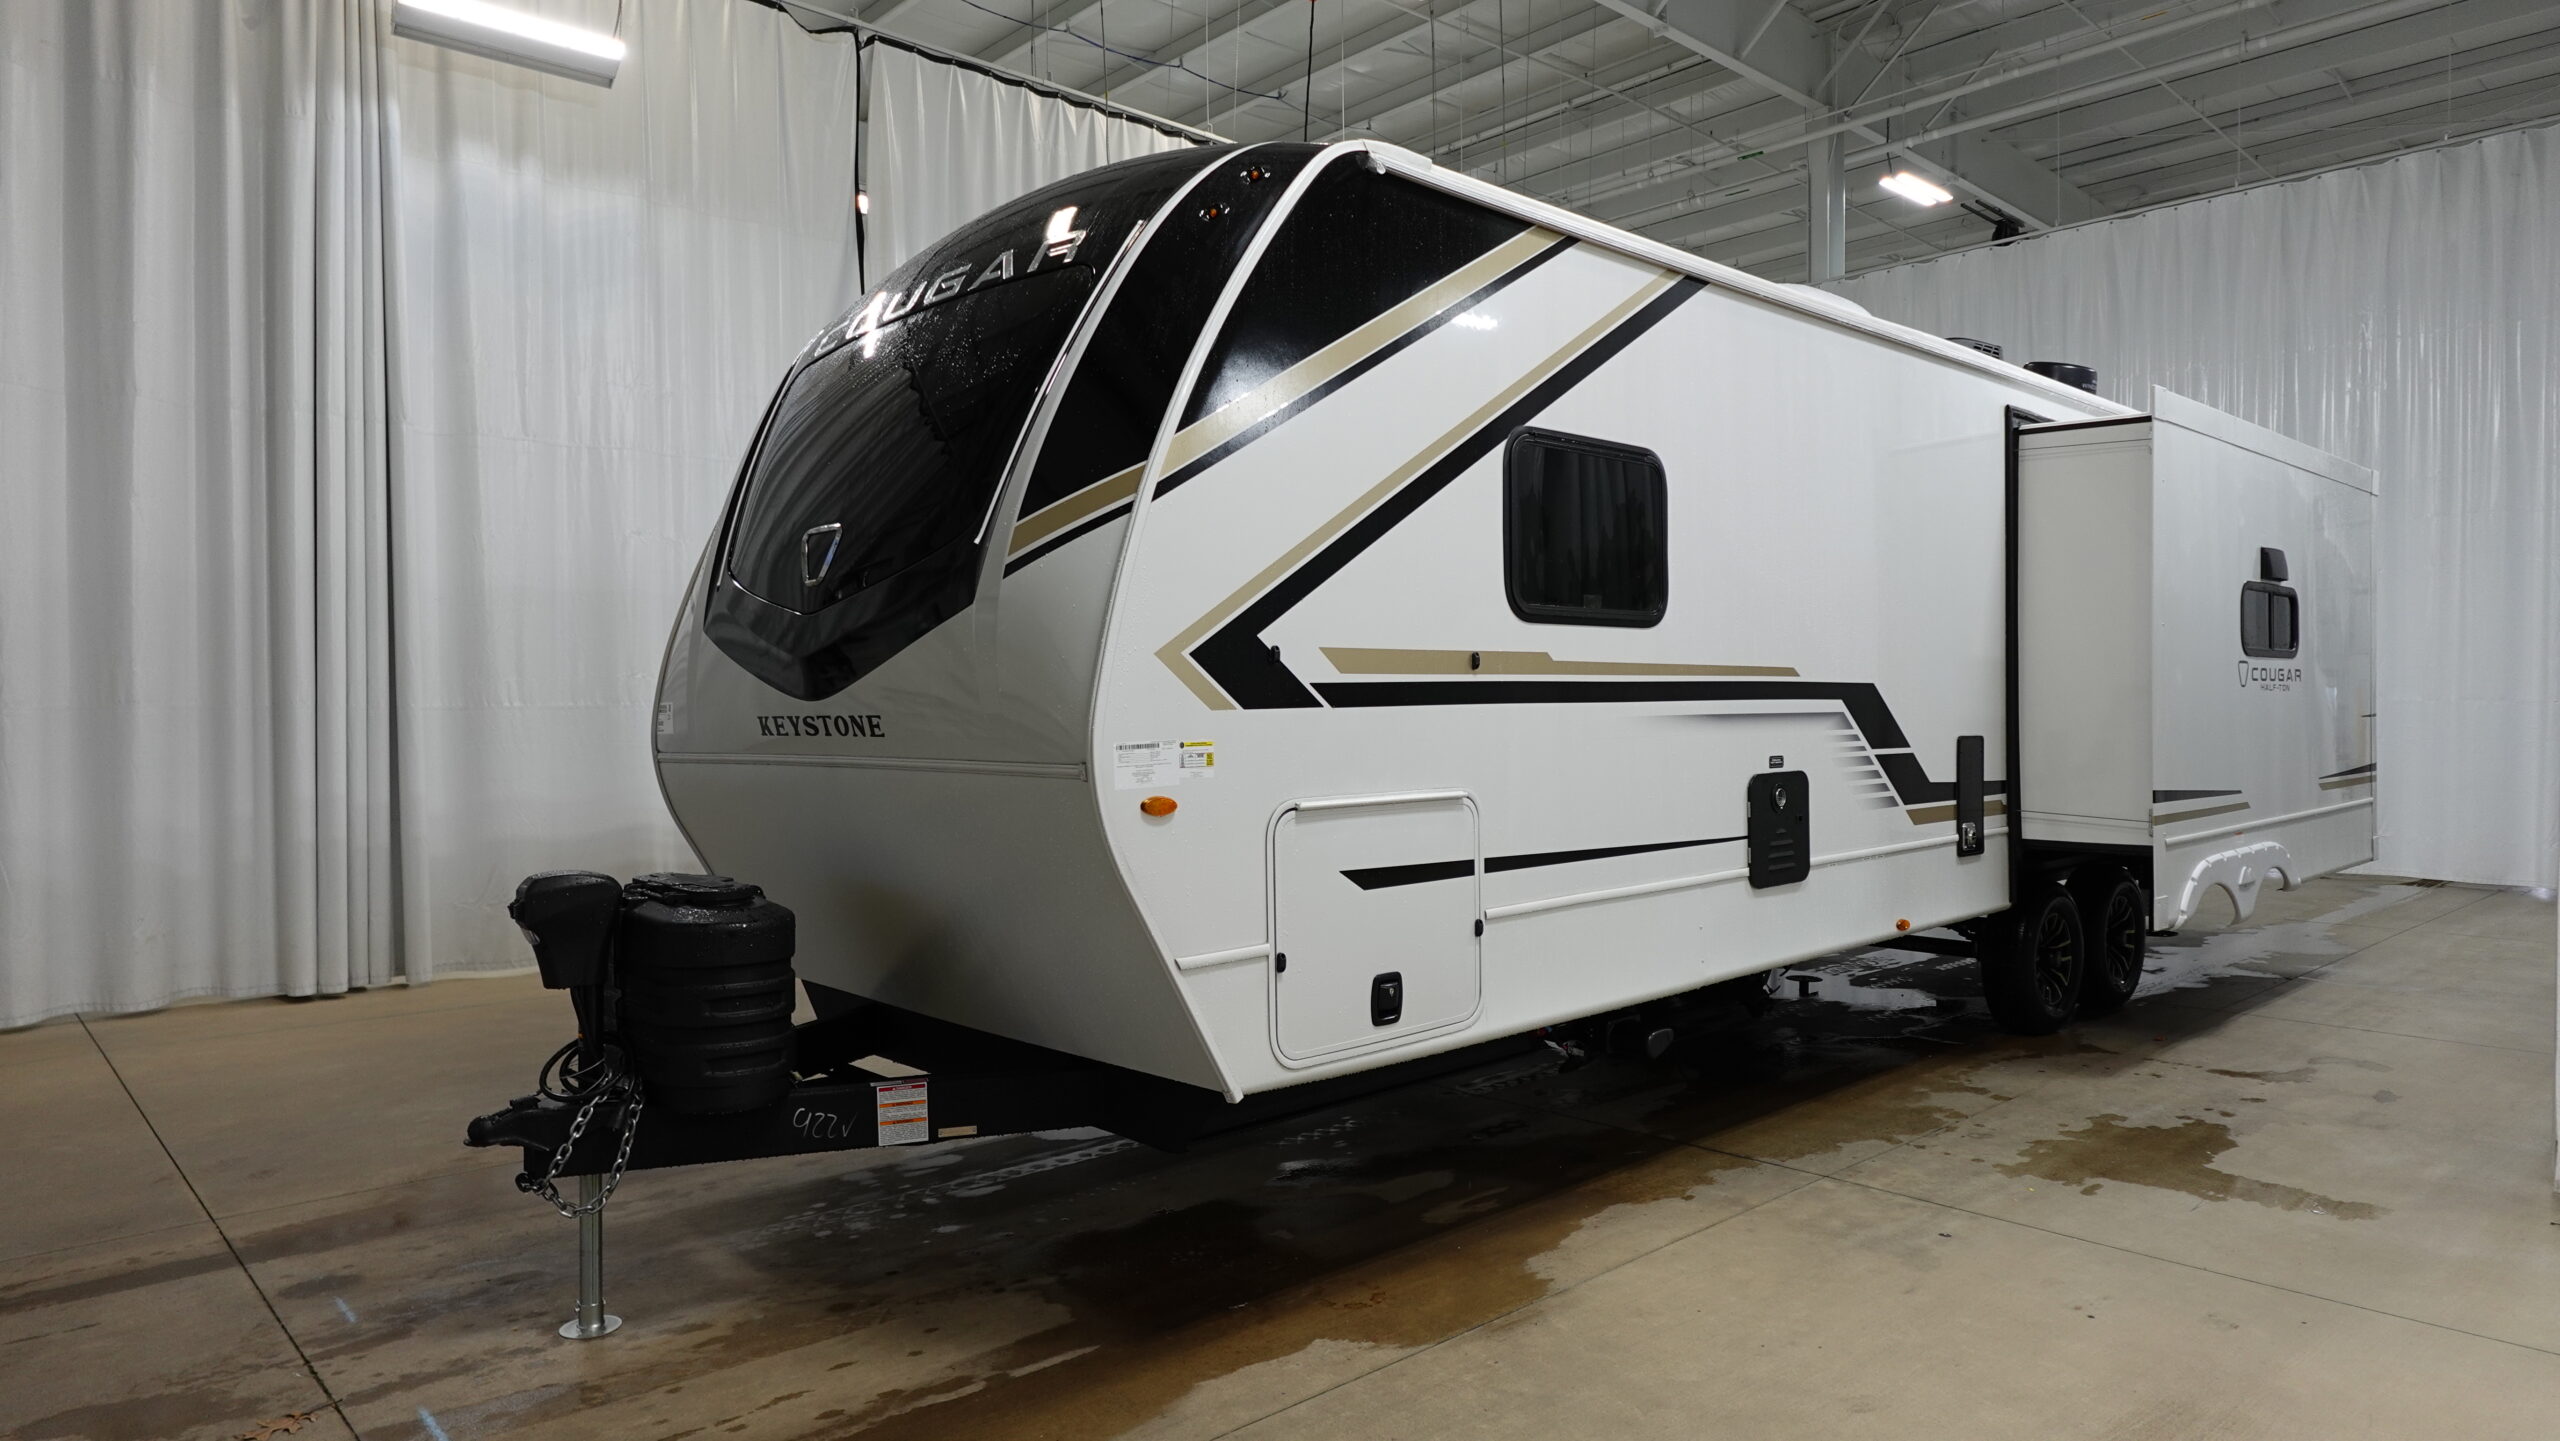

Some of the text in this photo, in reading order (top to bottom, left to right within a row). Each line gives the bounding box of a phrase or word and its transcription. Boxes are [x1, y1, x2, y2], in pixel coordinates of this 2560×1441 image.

[813, 230, 1087, 357] COUGAR
[2251, 667, 2302, 682] COUGAR
[757, 714, 886, 738] KEYSTONE
